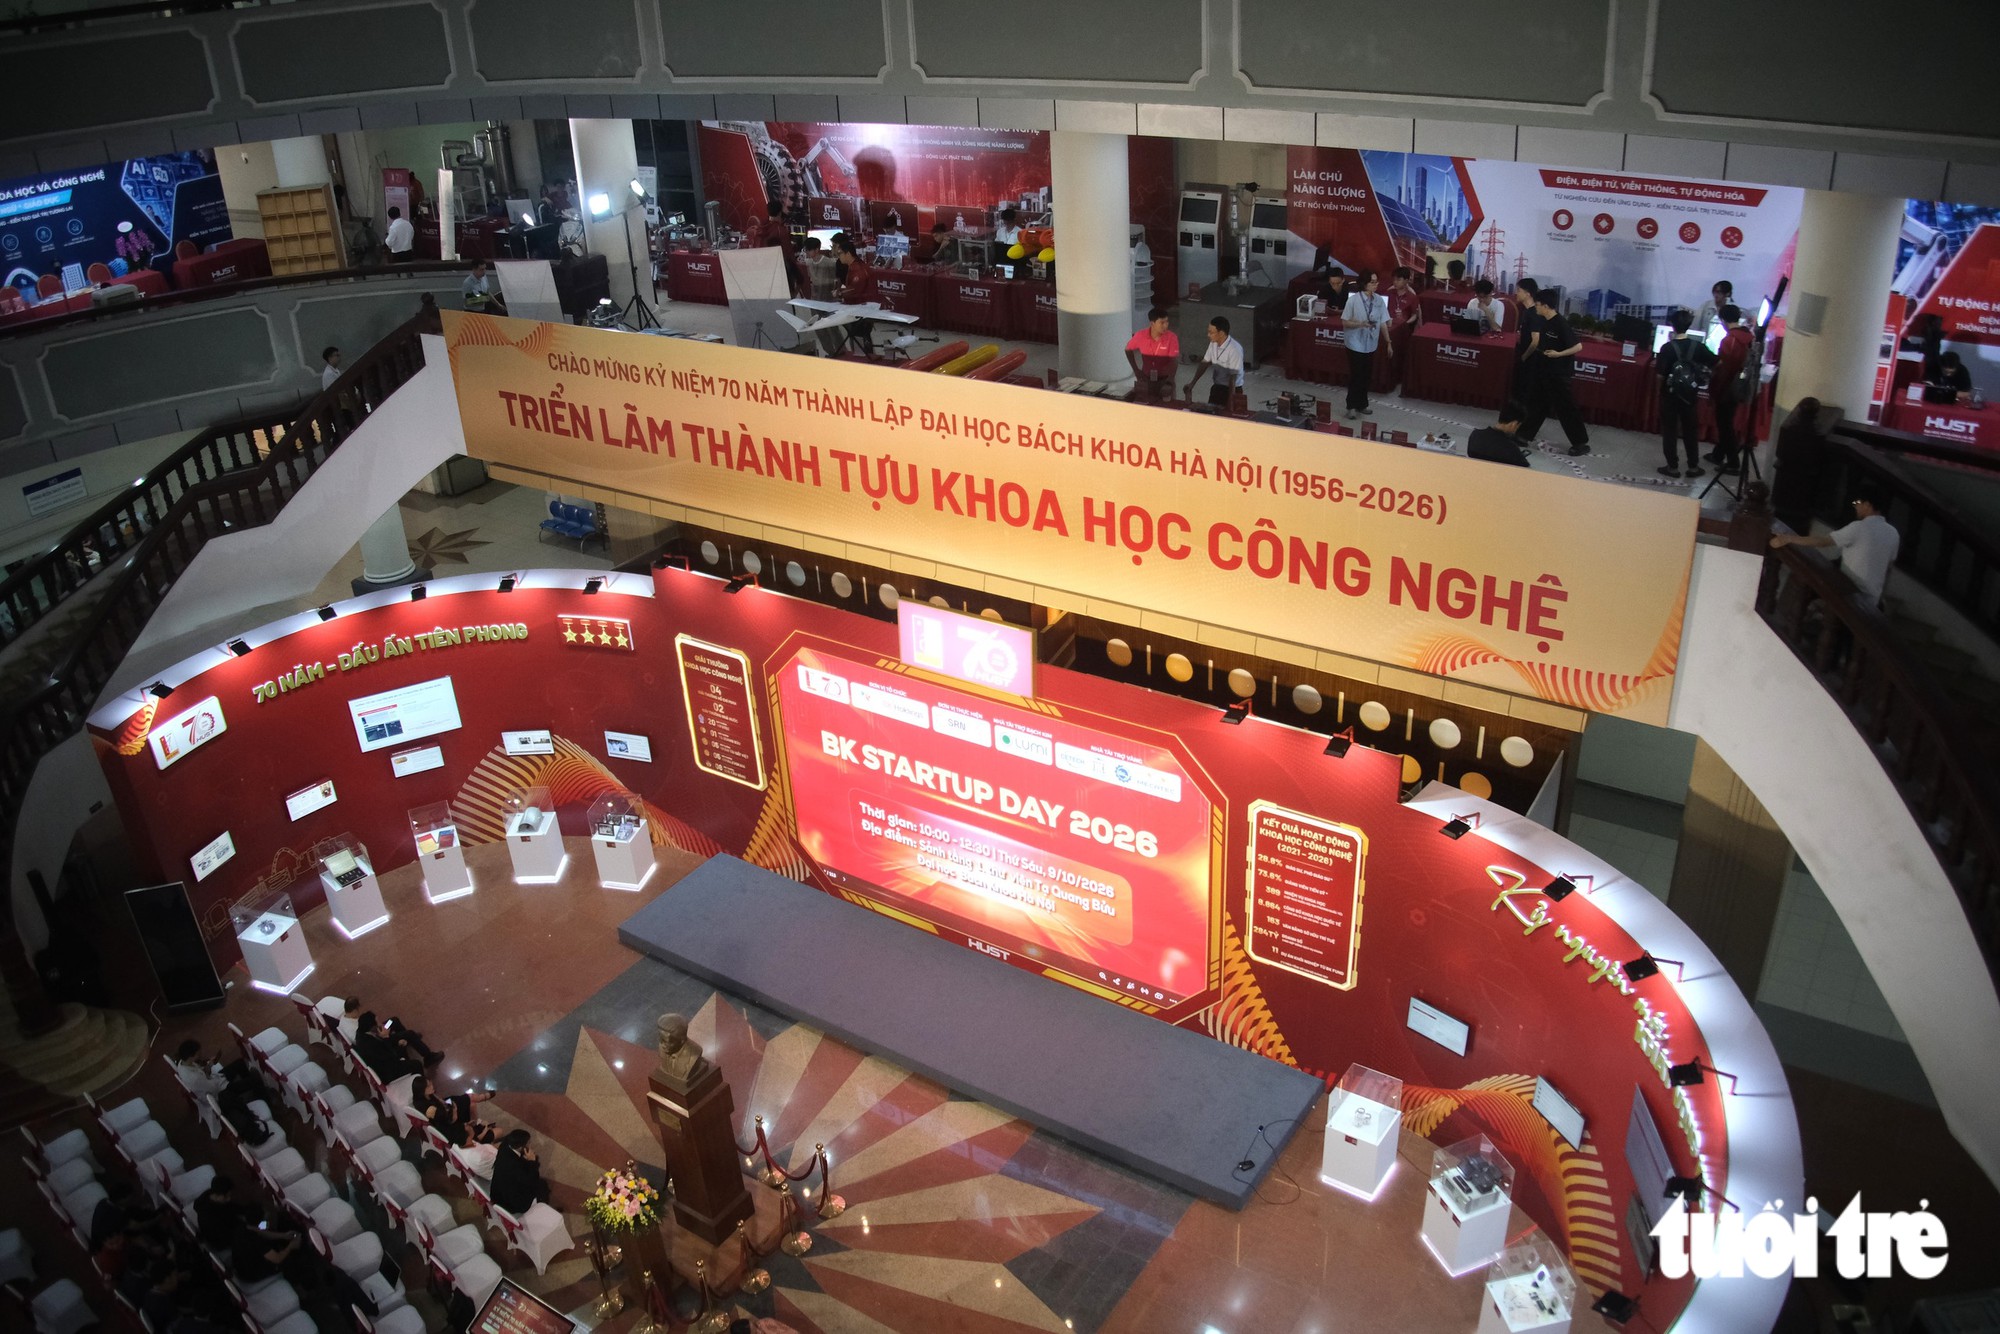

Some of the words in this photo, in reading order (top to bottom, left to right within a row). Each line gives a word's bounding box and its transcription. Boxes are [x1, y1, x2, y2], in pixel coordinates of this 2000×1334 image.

[132, 162, 146, 175] AI
[1294, 168, 1316, 180] LÀM
[1319, 171, 1342, 182] CHỦ
[14, 186, 36, 197] HỌC
[37, 182, 51, 192] VÀ
[52, 177, 78, 189] CÔNG
[80, 169, 105, 183] NGHỆ
[1556, 176, 1579, 186] ĐIỆN,
[1582, 178, 1602, 188] ĐIỆN
[1621, 181, 1641, 190] VIỄN
[1644, 184, 1678, 195] THÔNG,
[1680, 188, 1693, 197] TỰ
[1694, 188, 1722, 199] ĐỘNG
[1724, 191, 1745, 200] HÓA
[1293, 183, 1324, 195] NĂNG
[1328, 187, 1366, 199] LƯỢNG
[1340, 205, 1365, 213] THÔNG
[212, 265, 236, 278] HUST
[688, 262, 711, 271] HUST
[877, 280, 906, 291] HUST
[960, 286, 990, 298] HUST
[1036, 295, 1057, 306] HUS
[1938, 296, 1954, 308] TỰ
[1955, 298, 1989, 310] ĐỘNG
[1443, 305, 1467, 316] HUS
[1316, 328, 1344, 340] HUS
[1436, 344, 1480, 359] HUST
[1574, 361, 1608, 375] UST
[1925, 416, 1979, 434] HUST
[548, 352, 590, 375] CHÀO
[594, 356, 641, 383] MỪNG
[644, 362, 666, 387] KỶ
[672, 369, 715, 398] NIỆM
[718, 378, 741, 400] 70
[745, 379, 788, 407] NĂM
[792, 388, 865, 419] THÀNH
[870, 398, 913, 431] LẬP
[920, 408, 957, 440] ĐẠI
[964, 416, 1011, 447] HỌC
[1018, 422, 1084, 460] BÁCH
[1091, 437, 1163, 472] KHOA
[1170, 448, 1208, 479] HÀ
[1216, 456, 1262, 493] NỘI
[1269, 465, 1447, 525] (1956-2026)
[498, 382, 594, 442] TRIỂN
[599, 402, 676, 458] LÃM
[681, 422, 821, 487] THÀNH
[829, 449, 919, 512] TỰU
[932, 468, 1070, 537] KHOA
[1083, 496, 1192, 566] HỌC
[1208, 517, 1371, 597] CÔNG
[1389, 556, 1568, 654] NGHỆ
[253, 681, 278, 704] 70
[278, 662, 324, 693] NĂM
[338, 642, 380, 672] DẤU
[383, 633, 414, 659] ẤN
[414, 626, 462, 650] TIÊN
[462, 623, 528, 644] PHONG
[710, 684, 721, 695] 04
[713, 702, 724, 714] 02
[948, 719, 966, 730] SRN
[821, 730, 859, 765] BK
[862, 744, 994, 805] STARTUP
[999, 787, 1064, 828] DAY
[1069, 811, 1158, 857] 2026
[1263, 818, 1281, 828] KẾT
[1281, 823, 1299, 834] QUẢ
[1300, 828, 1324, 842] HOẠT
[1325, 836, 1350, 849] ĐỘNG
[860, 801, 885, 821] Thời
[887, 814, 918, 832] gian:
[919, 823, 950, 842] 10:00
[960, 837, 990, 856] 12:30
[998, 850, 1020, 867] Thứ
[1021, 858, 1046, 877] Sáu,
[1047, 866, 1115, 898] 9/10/2026
[1259, 828, 1283, 841] KHOA
[1285, 834, 1302, 846] HỌC
[1303, 840, 1328, 853] CÔNG
[1328, 848, 1353, 863] NGHỆ
[1277, 843, 1300, 856] (2021
[861, 819, 882, 836] Địa
[884, 827, 917, 848] điểm:
[919, 840, 946, 859] Sảnh
[1035, 880, 1050, 896] Tạ
[1051, 885, 1090, 911] Quang
[1091, 898, 1116, 916] Bửu
[917, 853, 936, 872] Đại
[1036, 897, 1056, 913] Nội
[968, 938, 1010, 960] HUST
